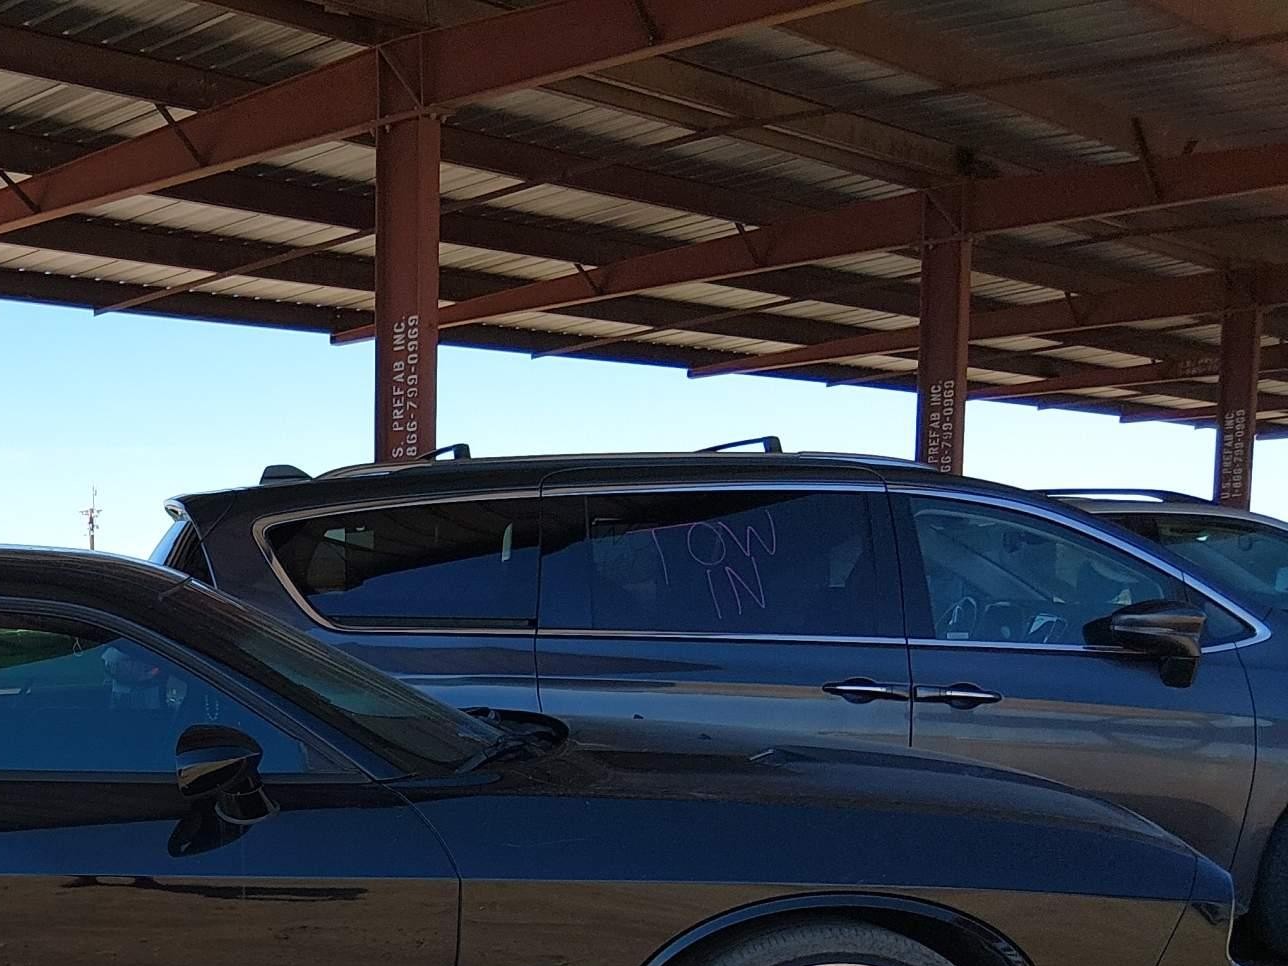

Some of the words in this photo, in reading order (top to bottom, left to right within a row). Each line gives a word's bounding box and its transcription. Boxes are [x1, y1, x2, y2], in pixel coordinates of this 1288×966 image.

[392, 361, 406, 431] PREFAB
[406, 315, 420, 457] 866-799-0969
[927, 411, 941, 464] PREFAB
[625, 510, 777, 585] TOW
[706, 556, 766, 620] IN
